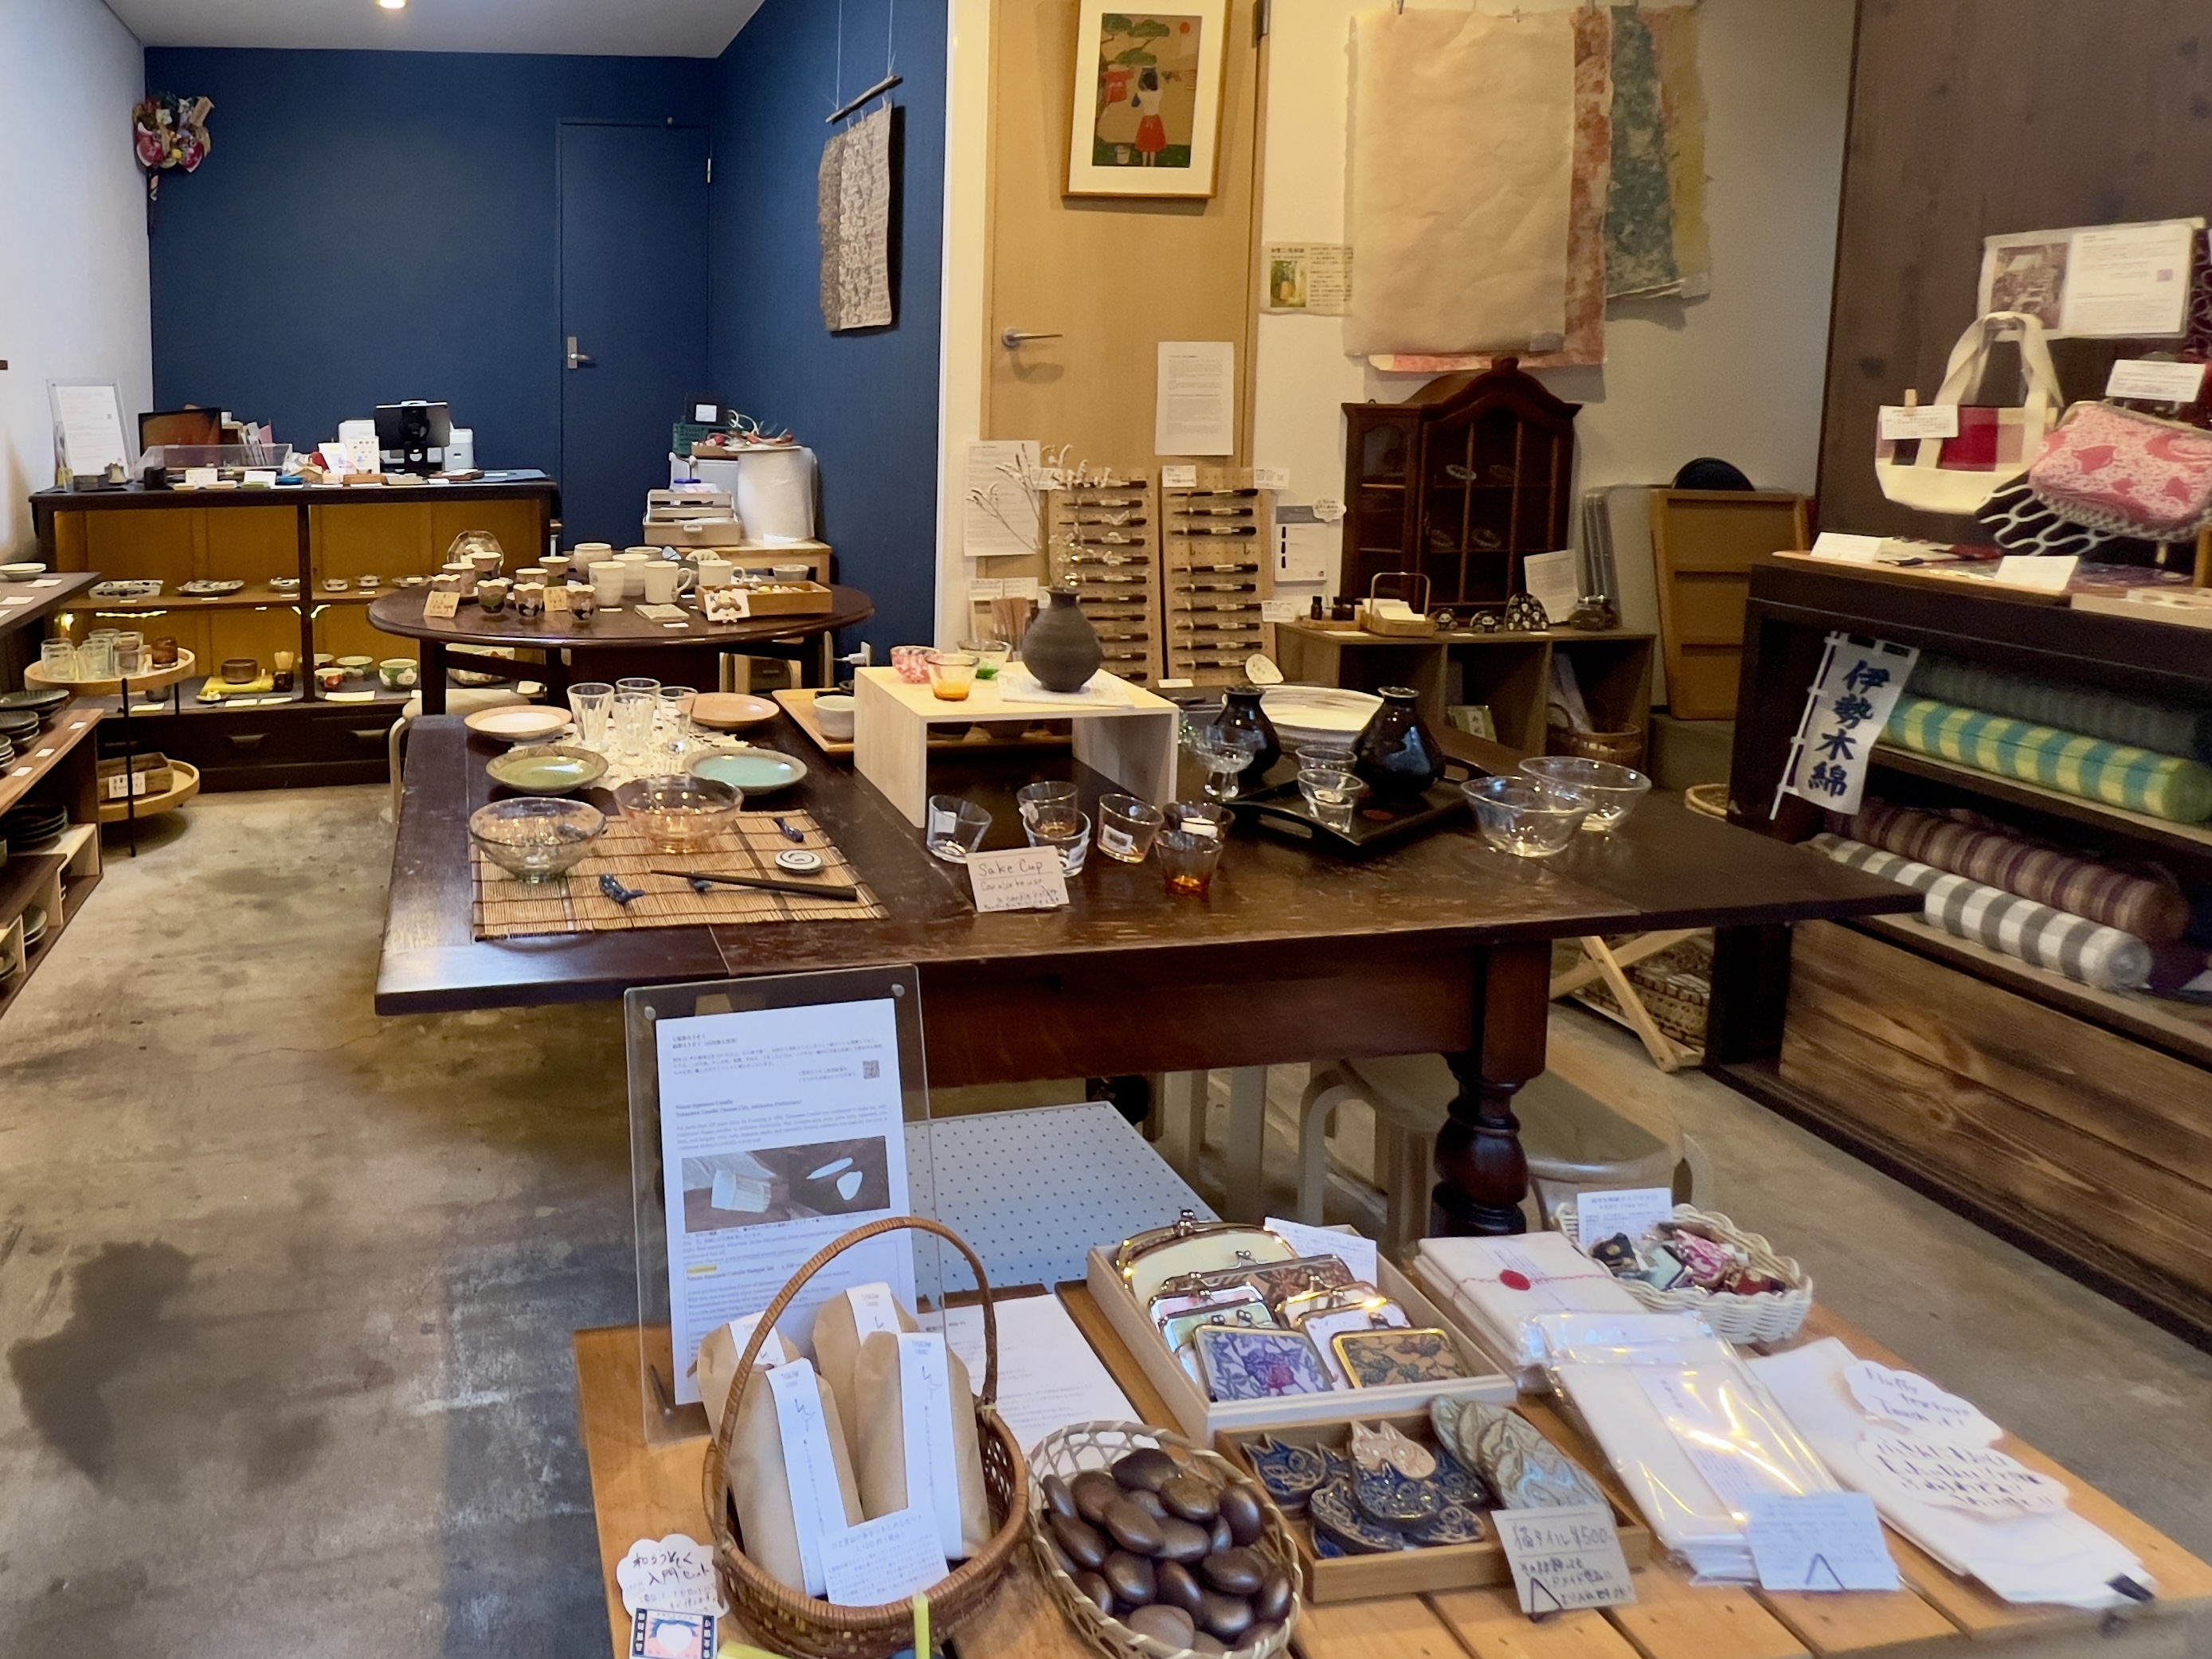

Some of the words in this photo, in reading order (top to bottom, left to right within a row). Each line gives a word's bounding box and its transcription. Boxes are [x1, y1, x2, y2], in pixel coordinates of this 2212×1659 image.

[1808, 659, 1891, 797] 伊勢木綿
[979, 860, 1014, 876] Sake
[1020, 859, 1043, 874] Cup
[648, 1563, 710, 1586] 入門セット
